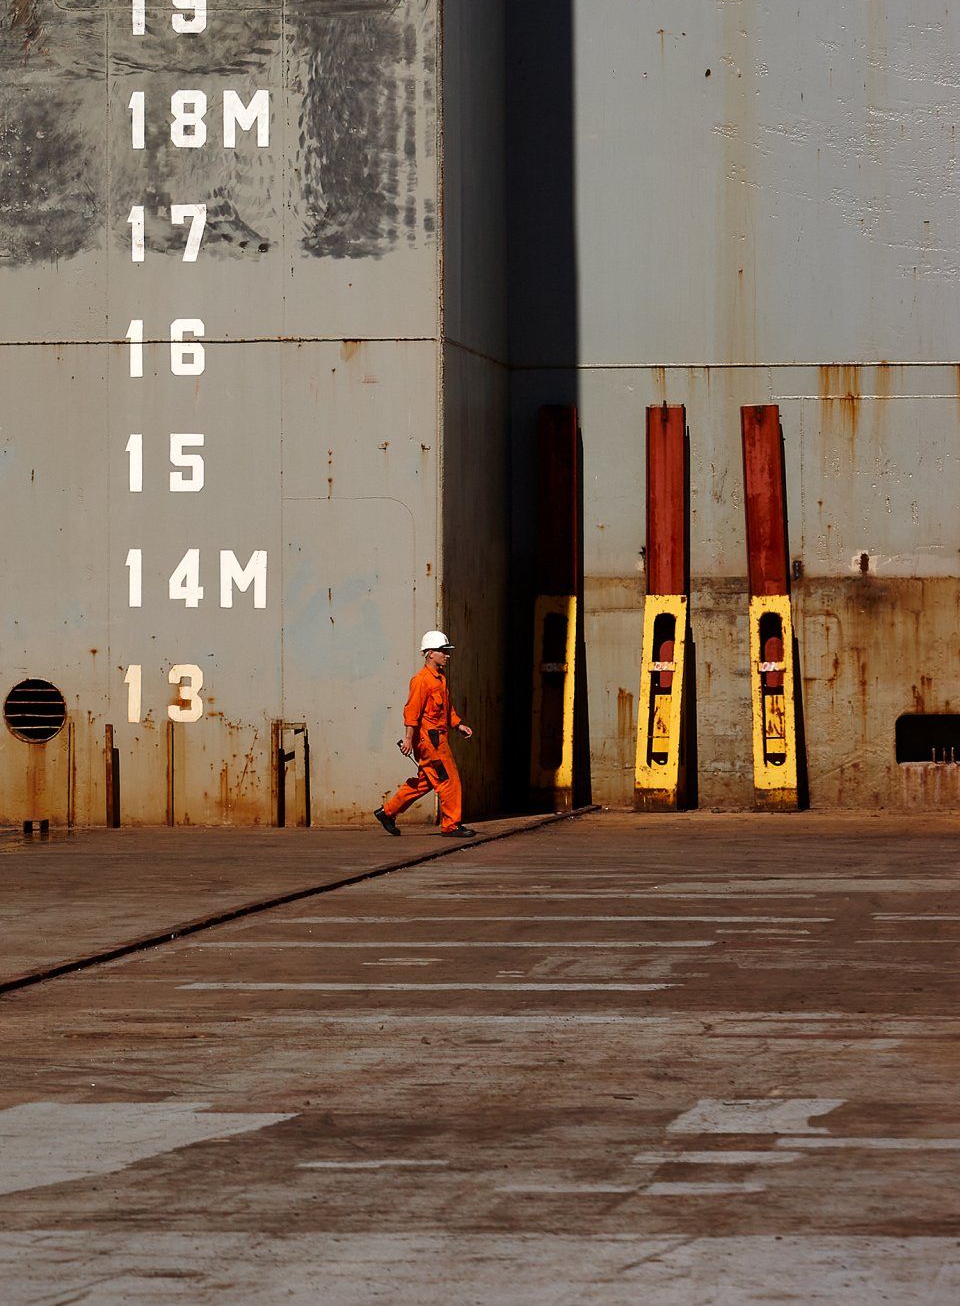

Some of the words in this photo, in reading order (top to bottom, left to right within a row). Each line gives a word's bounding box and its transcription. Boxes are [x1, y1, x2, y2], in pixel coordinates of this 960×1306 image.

[128, 90, 270, 149] 18M
[126, 204, 207, 263] 17
[125, 318, 206, 377] 16
[124, 433, 205, 492] 15
[124, 549, 268, 608] 14M
[123, 664, 204, 723] 13
